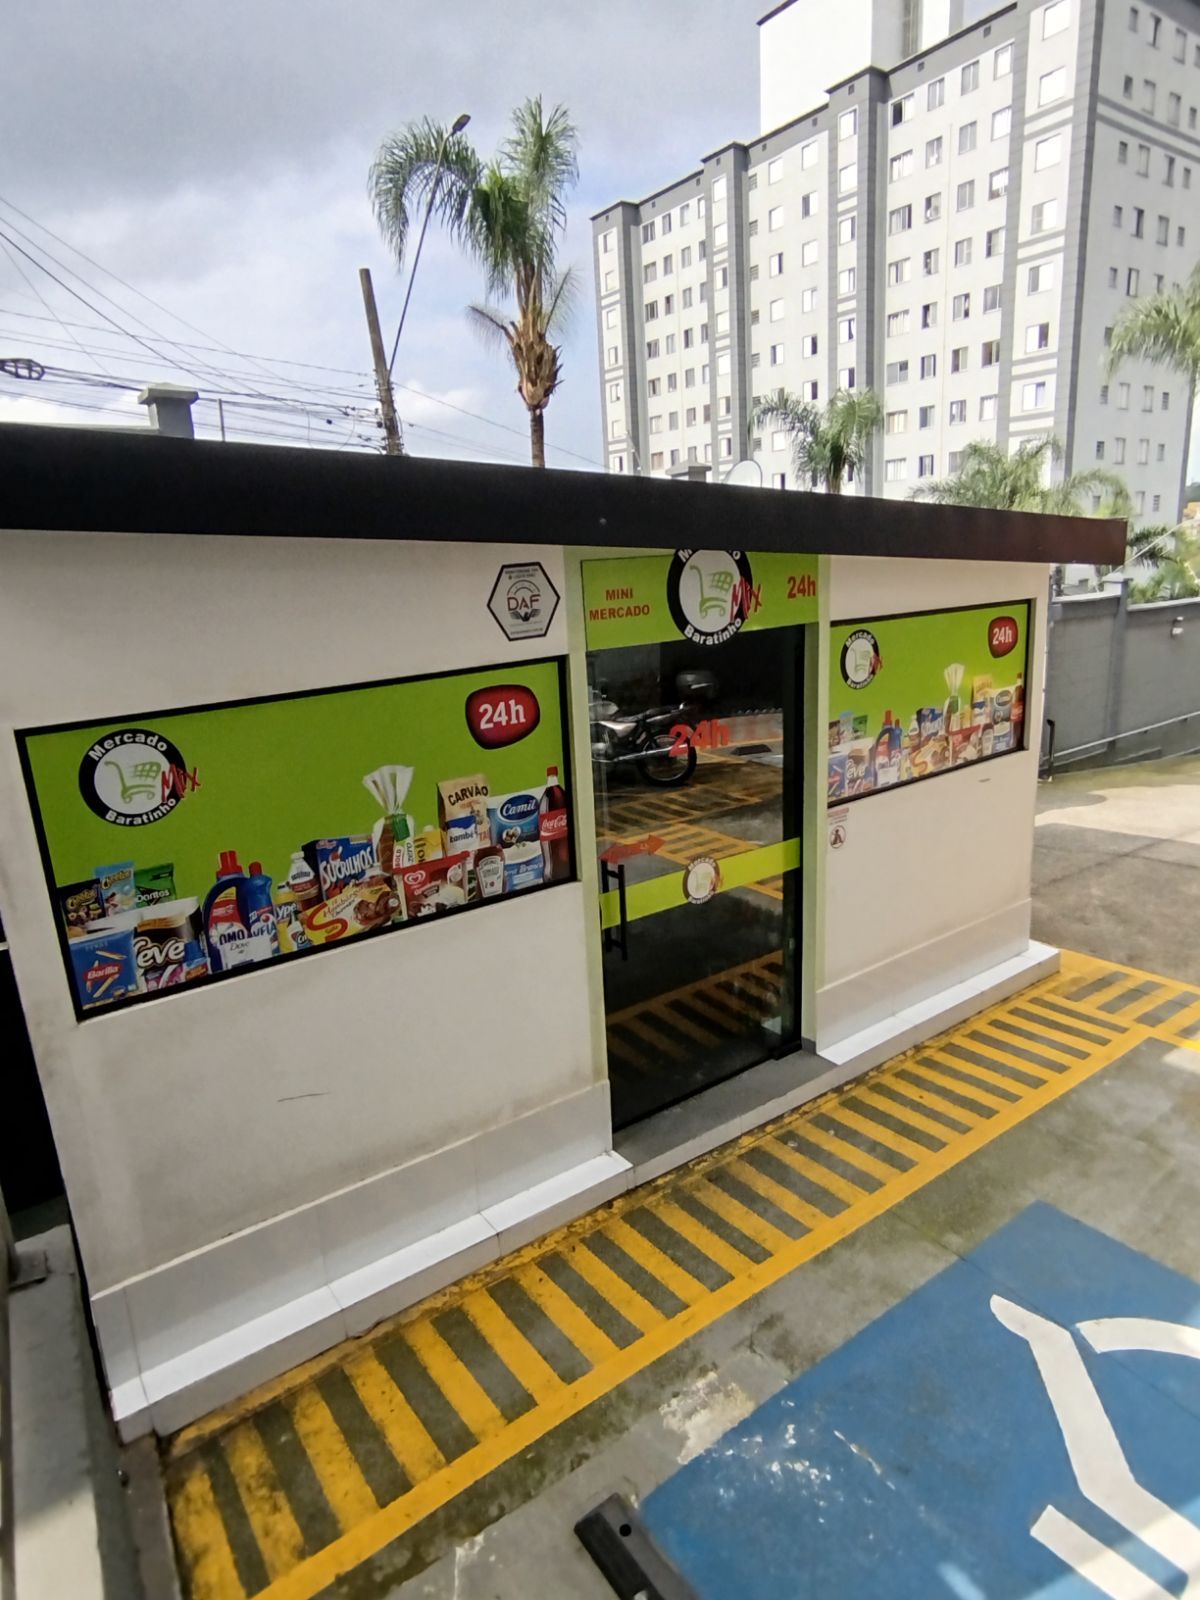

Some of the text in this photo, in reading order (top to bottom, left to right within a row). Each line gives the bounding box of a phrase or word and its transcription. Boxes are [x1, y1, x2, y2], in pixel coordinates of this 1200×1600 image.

[605, 587, 633, 601] MINI
[787, 574, 816, 599] 24h
[589, 604, 650, 621] MERCADO
[683, 617, 742, 646] Baratinho
[992, 626, 1013, 645] 24h
[479, 699, 526, 730] 24h
[88, 731, 168, 762] Mercado
[668, 719, 731, 758] 24h
[104, 797, 177, 826] Baratinho
[502, 799, 536, 817] Camil
[320, 846, 375, 889] SUCRILHOS
[135, 888, 170, 903] Doritos
[87, 964, 119, 980] Barilla
